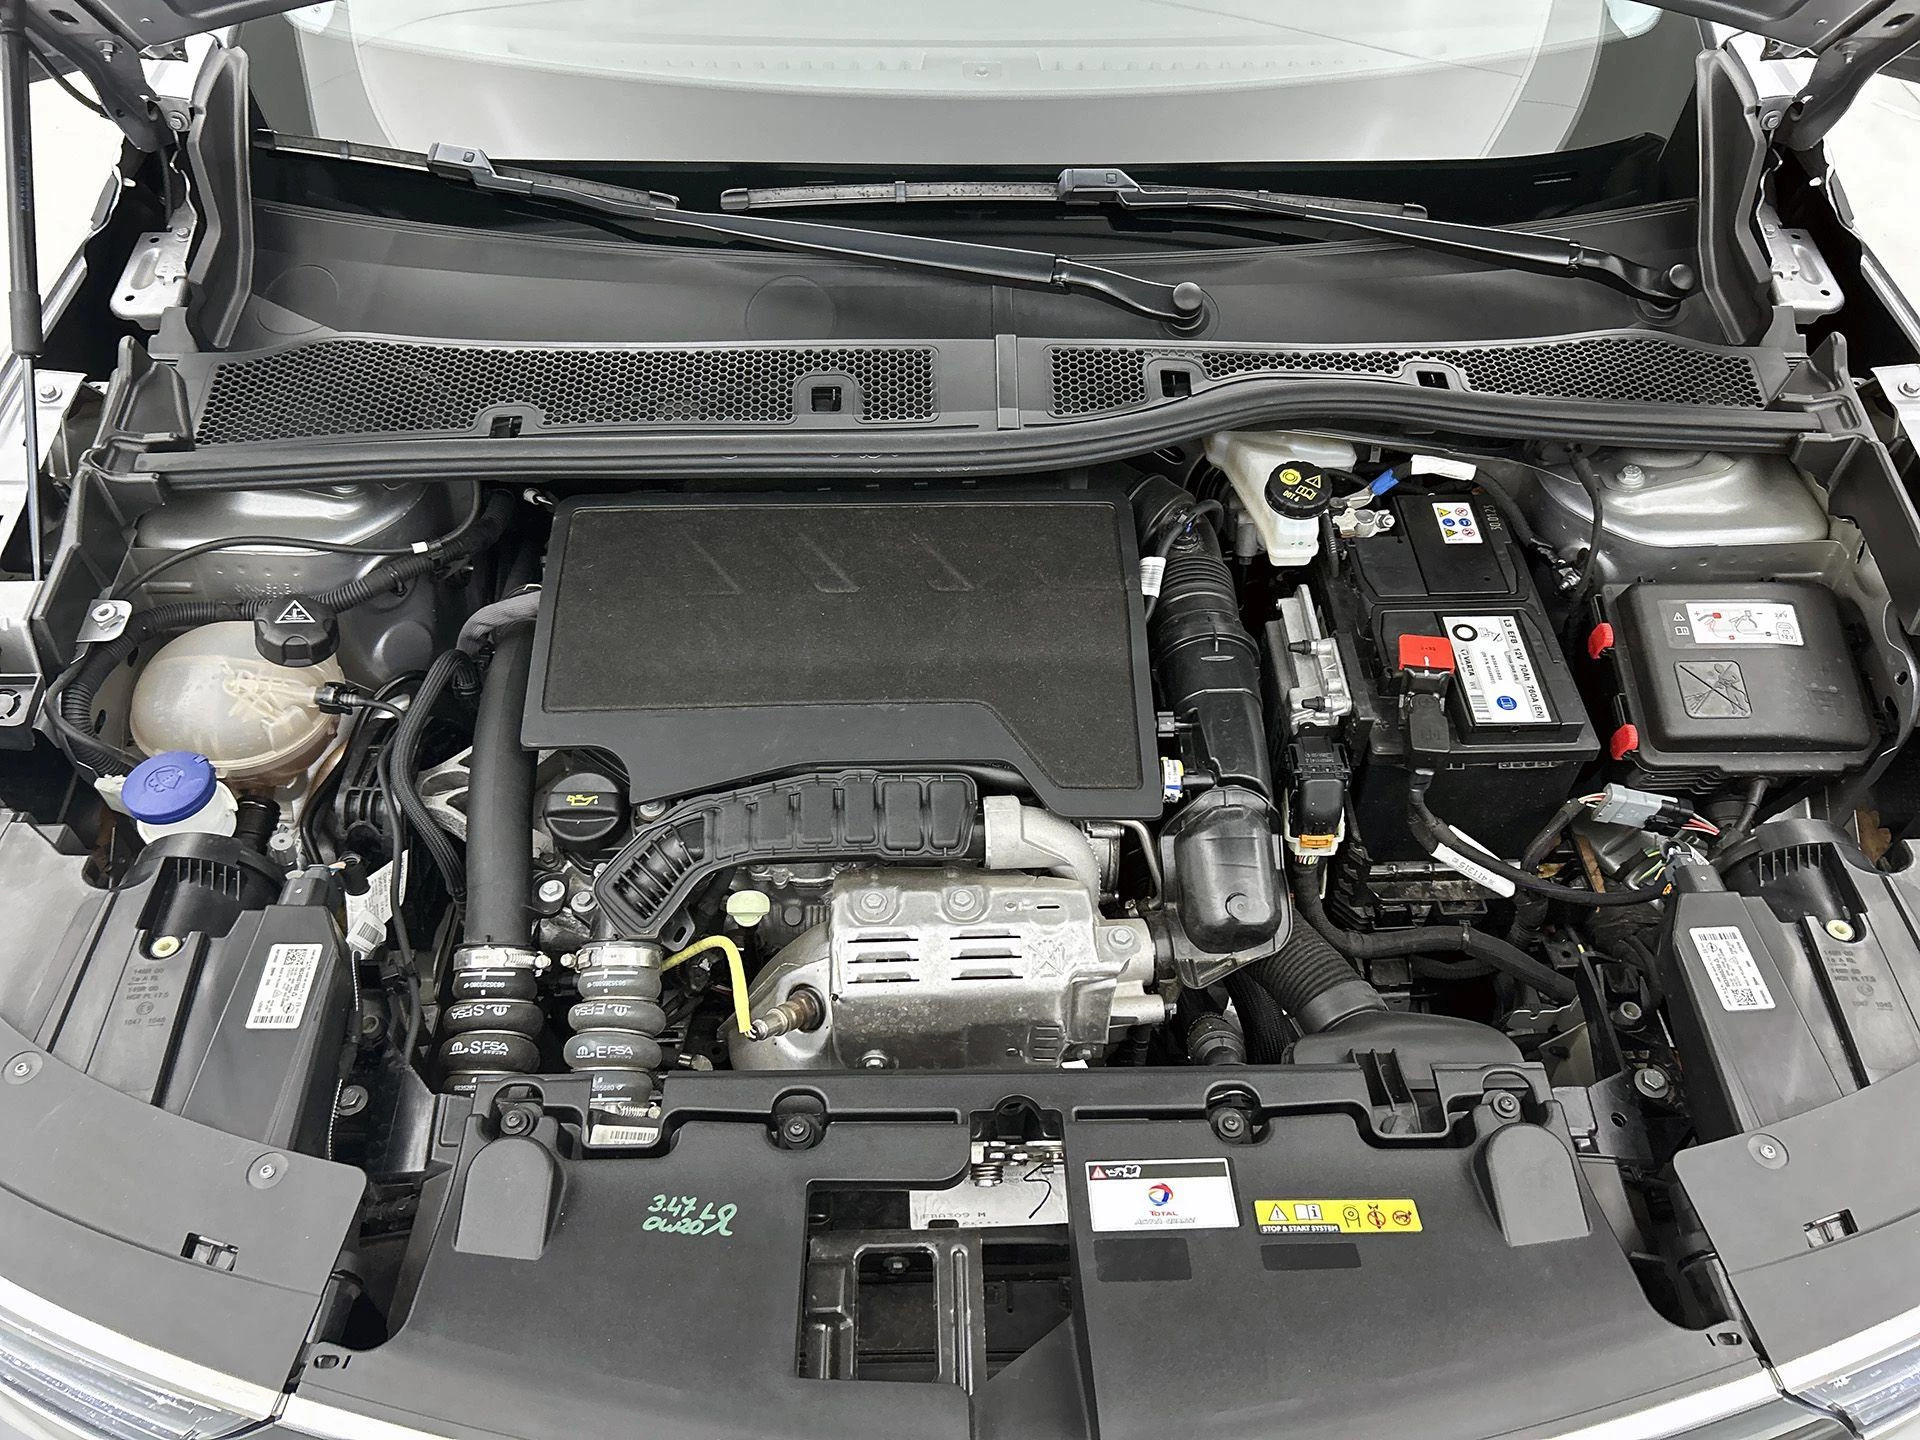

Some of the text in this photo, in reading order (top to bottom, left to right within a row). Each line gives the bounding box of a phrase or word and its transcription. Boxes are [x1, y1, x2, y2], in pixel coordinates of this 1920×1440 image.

[1283, 490, 1296, 500] DOT
[1503, 619, 1513, 628] L3
[1508, 631, 1519, 644] EFB
[1514, 648, 1526, 661] 12V
[1464, 656, 1475, 677] VARTA
[1520, 664, 1531, 682] 70Ah
[1527, 685, 1539, 703] 760A
[1532, 704, 1545, 719] (EN)
[596, 1046, 607, 1058] E
[607, 1046, 634, 1055] PSA
[1262, 1225, 1281, 1233] STOP
[1289, 1225, 1310, 1233] START
[1311, 1225, 1339, 1233] SYSTEM
